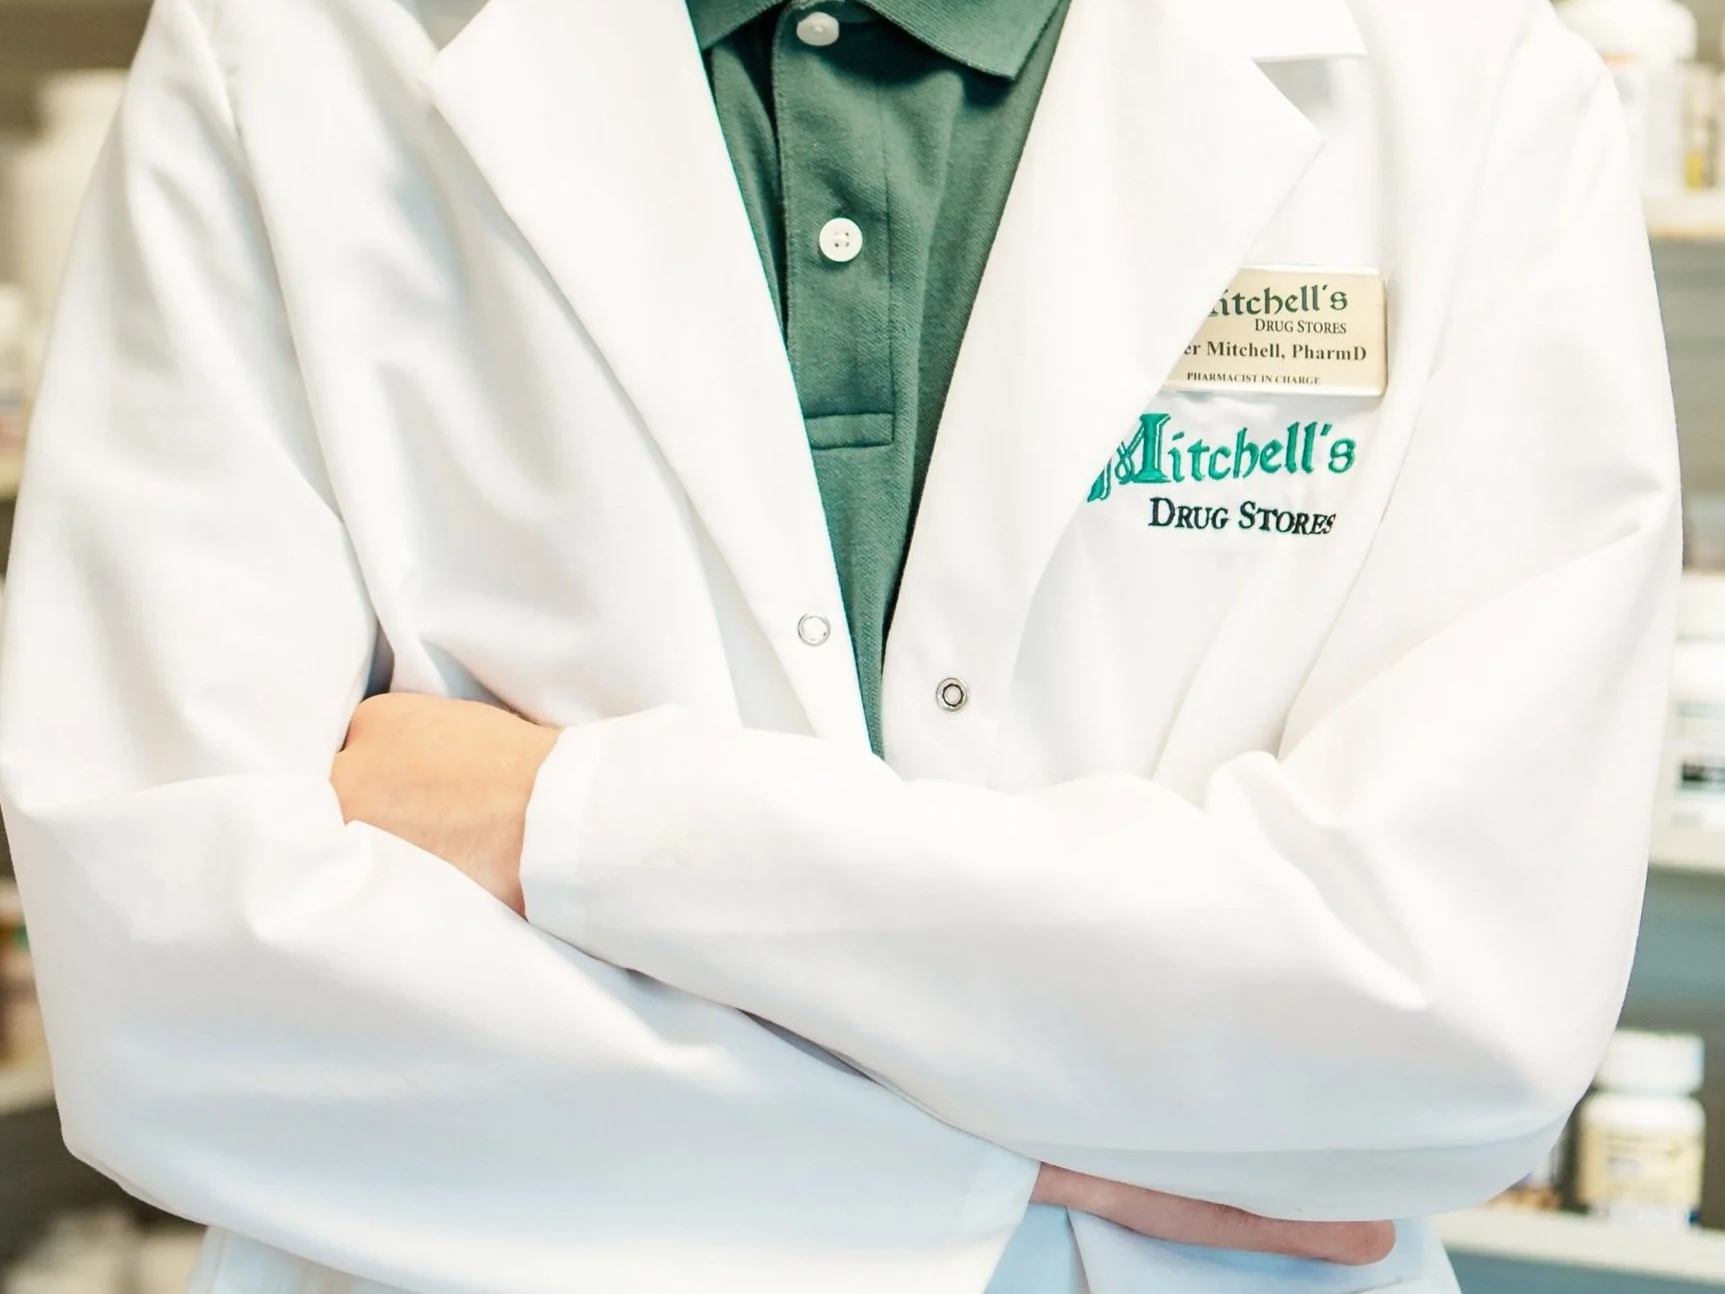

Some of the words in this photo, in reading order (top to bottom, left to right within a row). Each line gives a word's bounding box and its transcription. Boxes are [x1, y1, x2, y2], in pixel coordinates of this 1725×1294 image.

[1208, 284, 1348, 317] itchell's
[1255, 318, 1294, 333] DRUG
[1297, 319, 1347, 335] STORES
[1207, 341, 1286, 361] Mitchell,
[1292, 344, 1367, 361] PharmD
[1187, 372, 1258, 383] PHARMACIST
[1261, 375, 1272, 383] IN
[1275, 375, 1321, 385] CHARGE
[1148, 497, 1229, 529] DRUG
[1238, 501, 1337, 535] STORES
